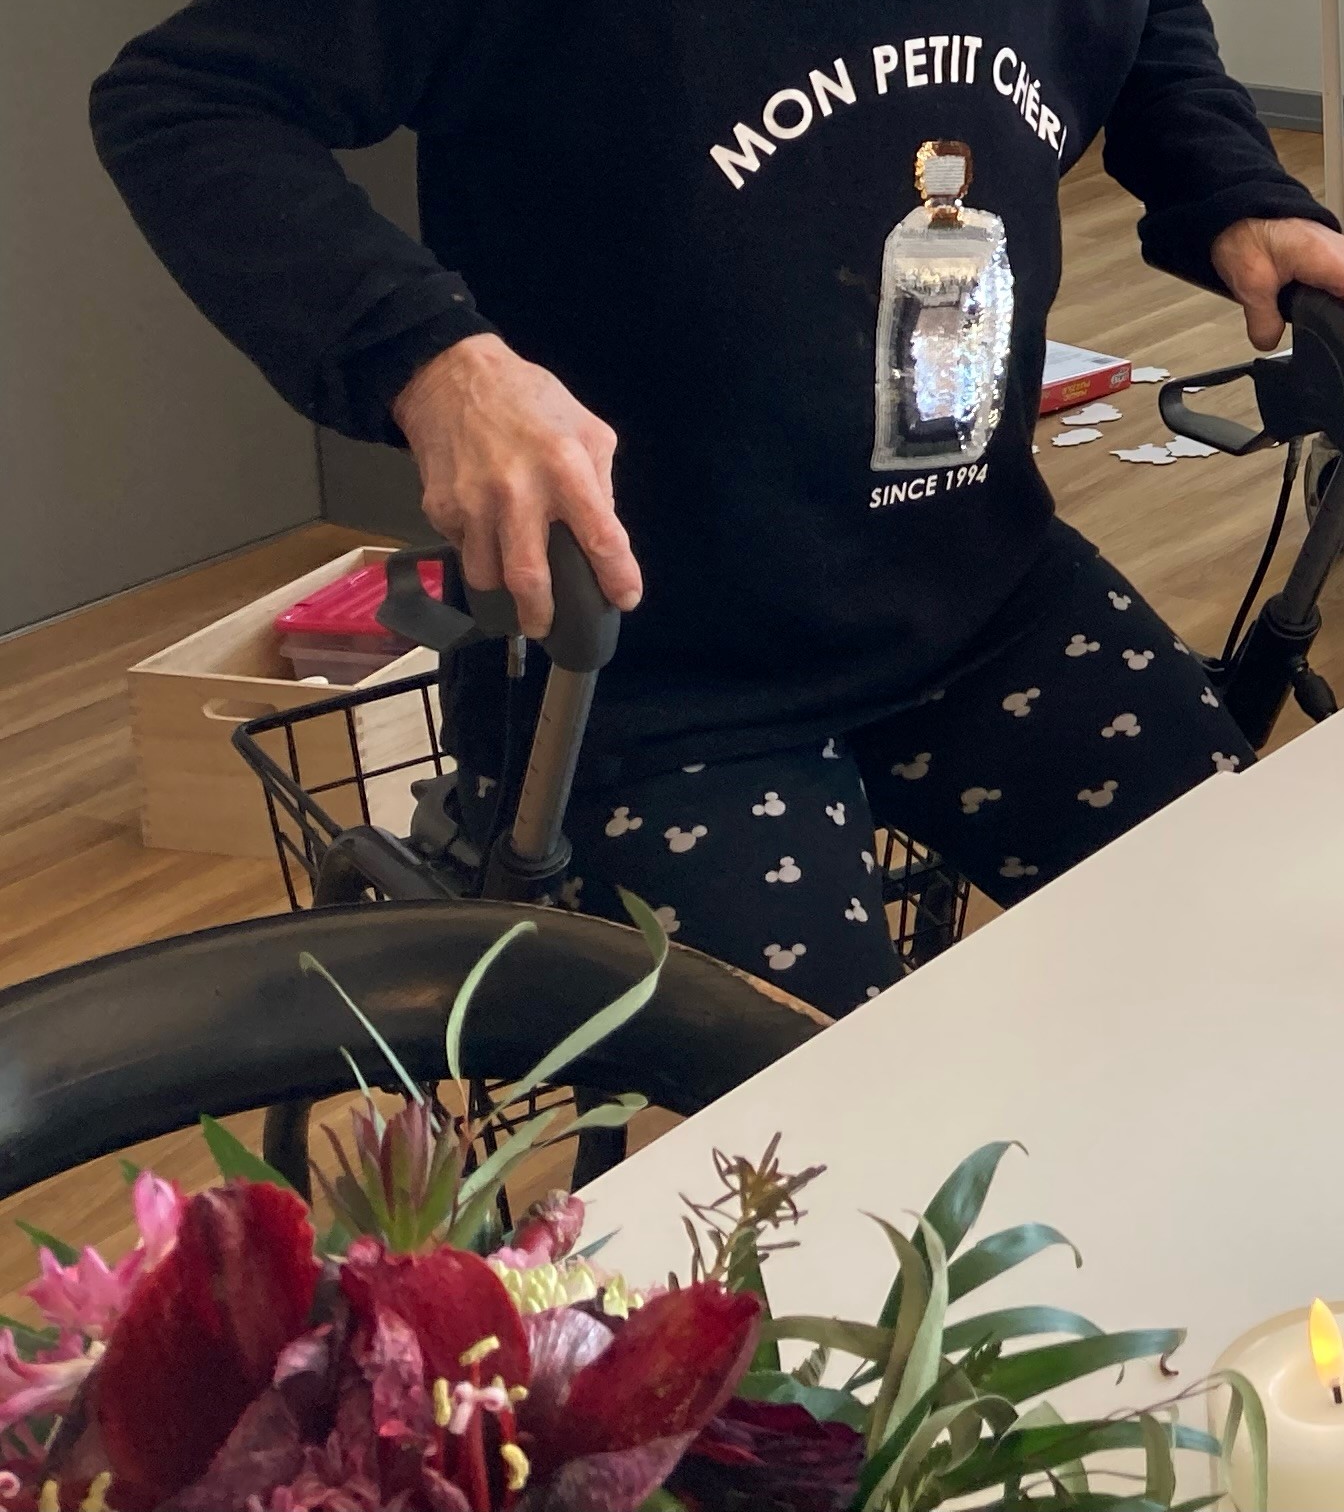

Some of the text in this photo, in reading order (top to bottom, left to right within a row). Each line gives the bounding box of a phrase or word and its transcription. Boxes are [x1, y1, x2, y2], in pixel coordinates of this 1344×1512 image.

[709, 57, 857, 190] MON
[872, 34, 983, 96] PETIT
[868, 463, 989, 509] SINCE 1994
